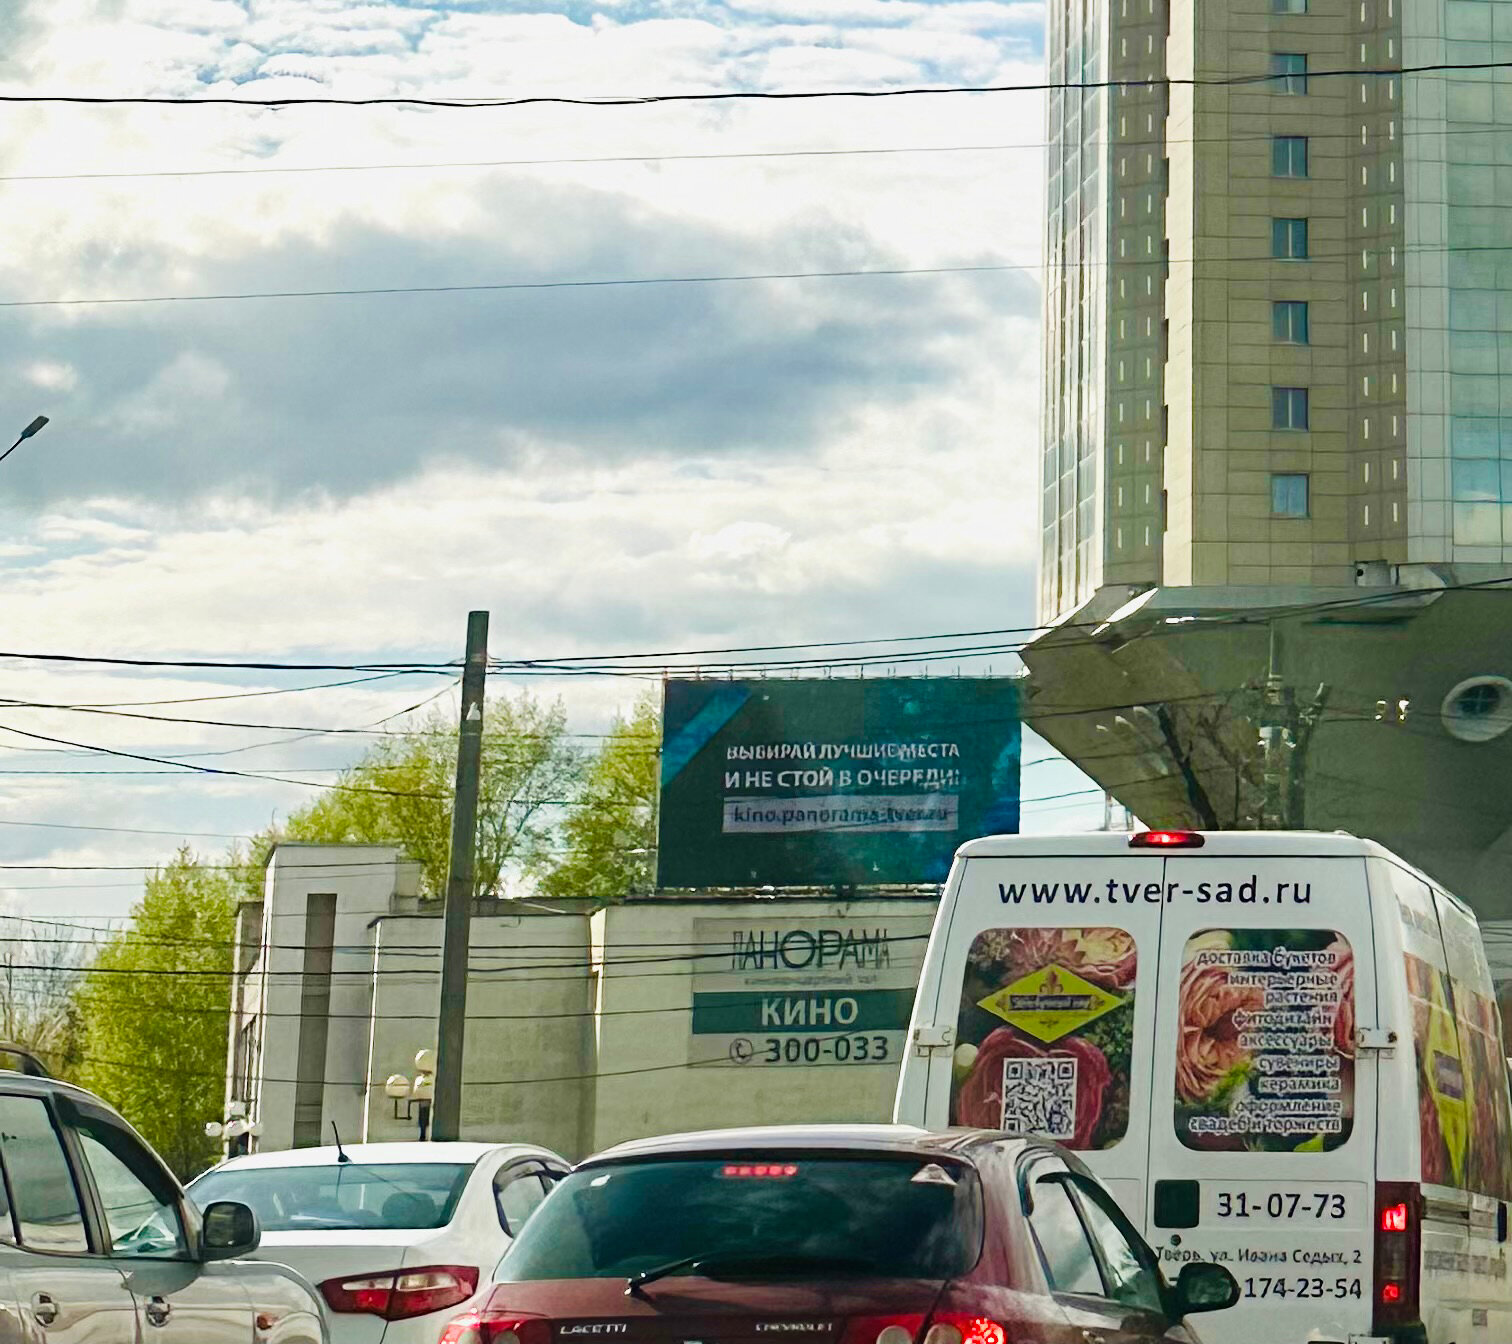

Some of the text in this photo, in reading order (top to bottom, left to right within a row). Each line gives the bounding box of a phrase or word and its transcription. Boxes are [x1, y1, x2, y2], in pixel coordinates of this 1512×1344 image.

[727, 742, 816, 760] ВЫБИРАЙ
[725, 772, 740, 788] И
[745, 771, 773, 787] НЕ
[777, 766, 833, 787] СТОЙ
[839, 770, 852, 786] В
[998, 874, 1312, 904] www.tver-sad.ru
[732, 927, 890, 971] ПАНОРАМА
[1265, 992, 1339, 1007] растения
[761, 997, 859, 1026] КИНО
[764, 1035, 889, 1062] 300-033
[1238, 1034, 1332, 1049] аксессуары
[1259, 1056, 1338, 1071] сувениры
[1261, 1078, 1339, 1093] керамика
[1217, 1192, 1346, 1218] 31-07-73
[1353, 1250, 1362, 1264] 2
